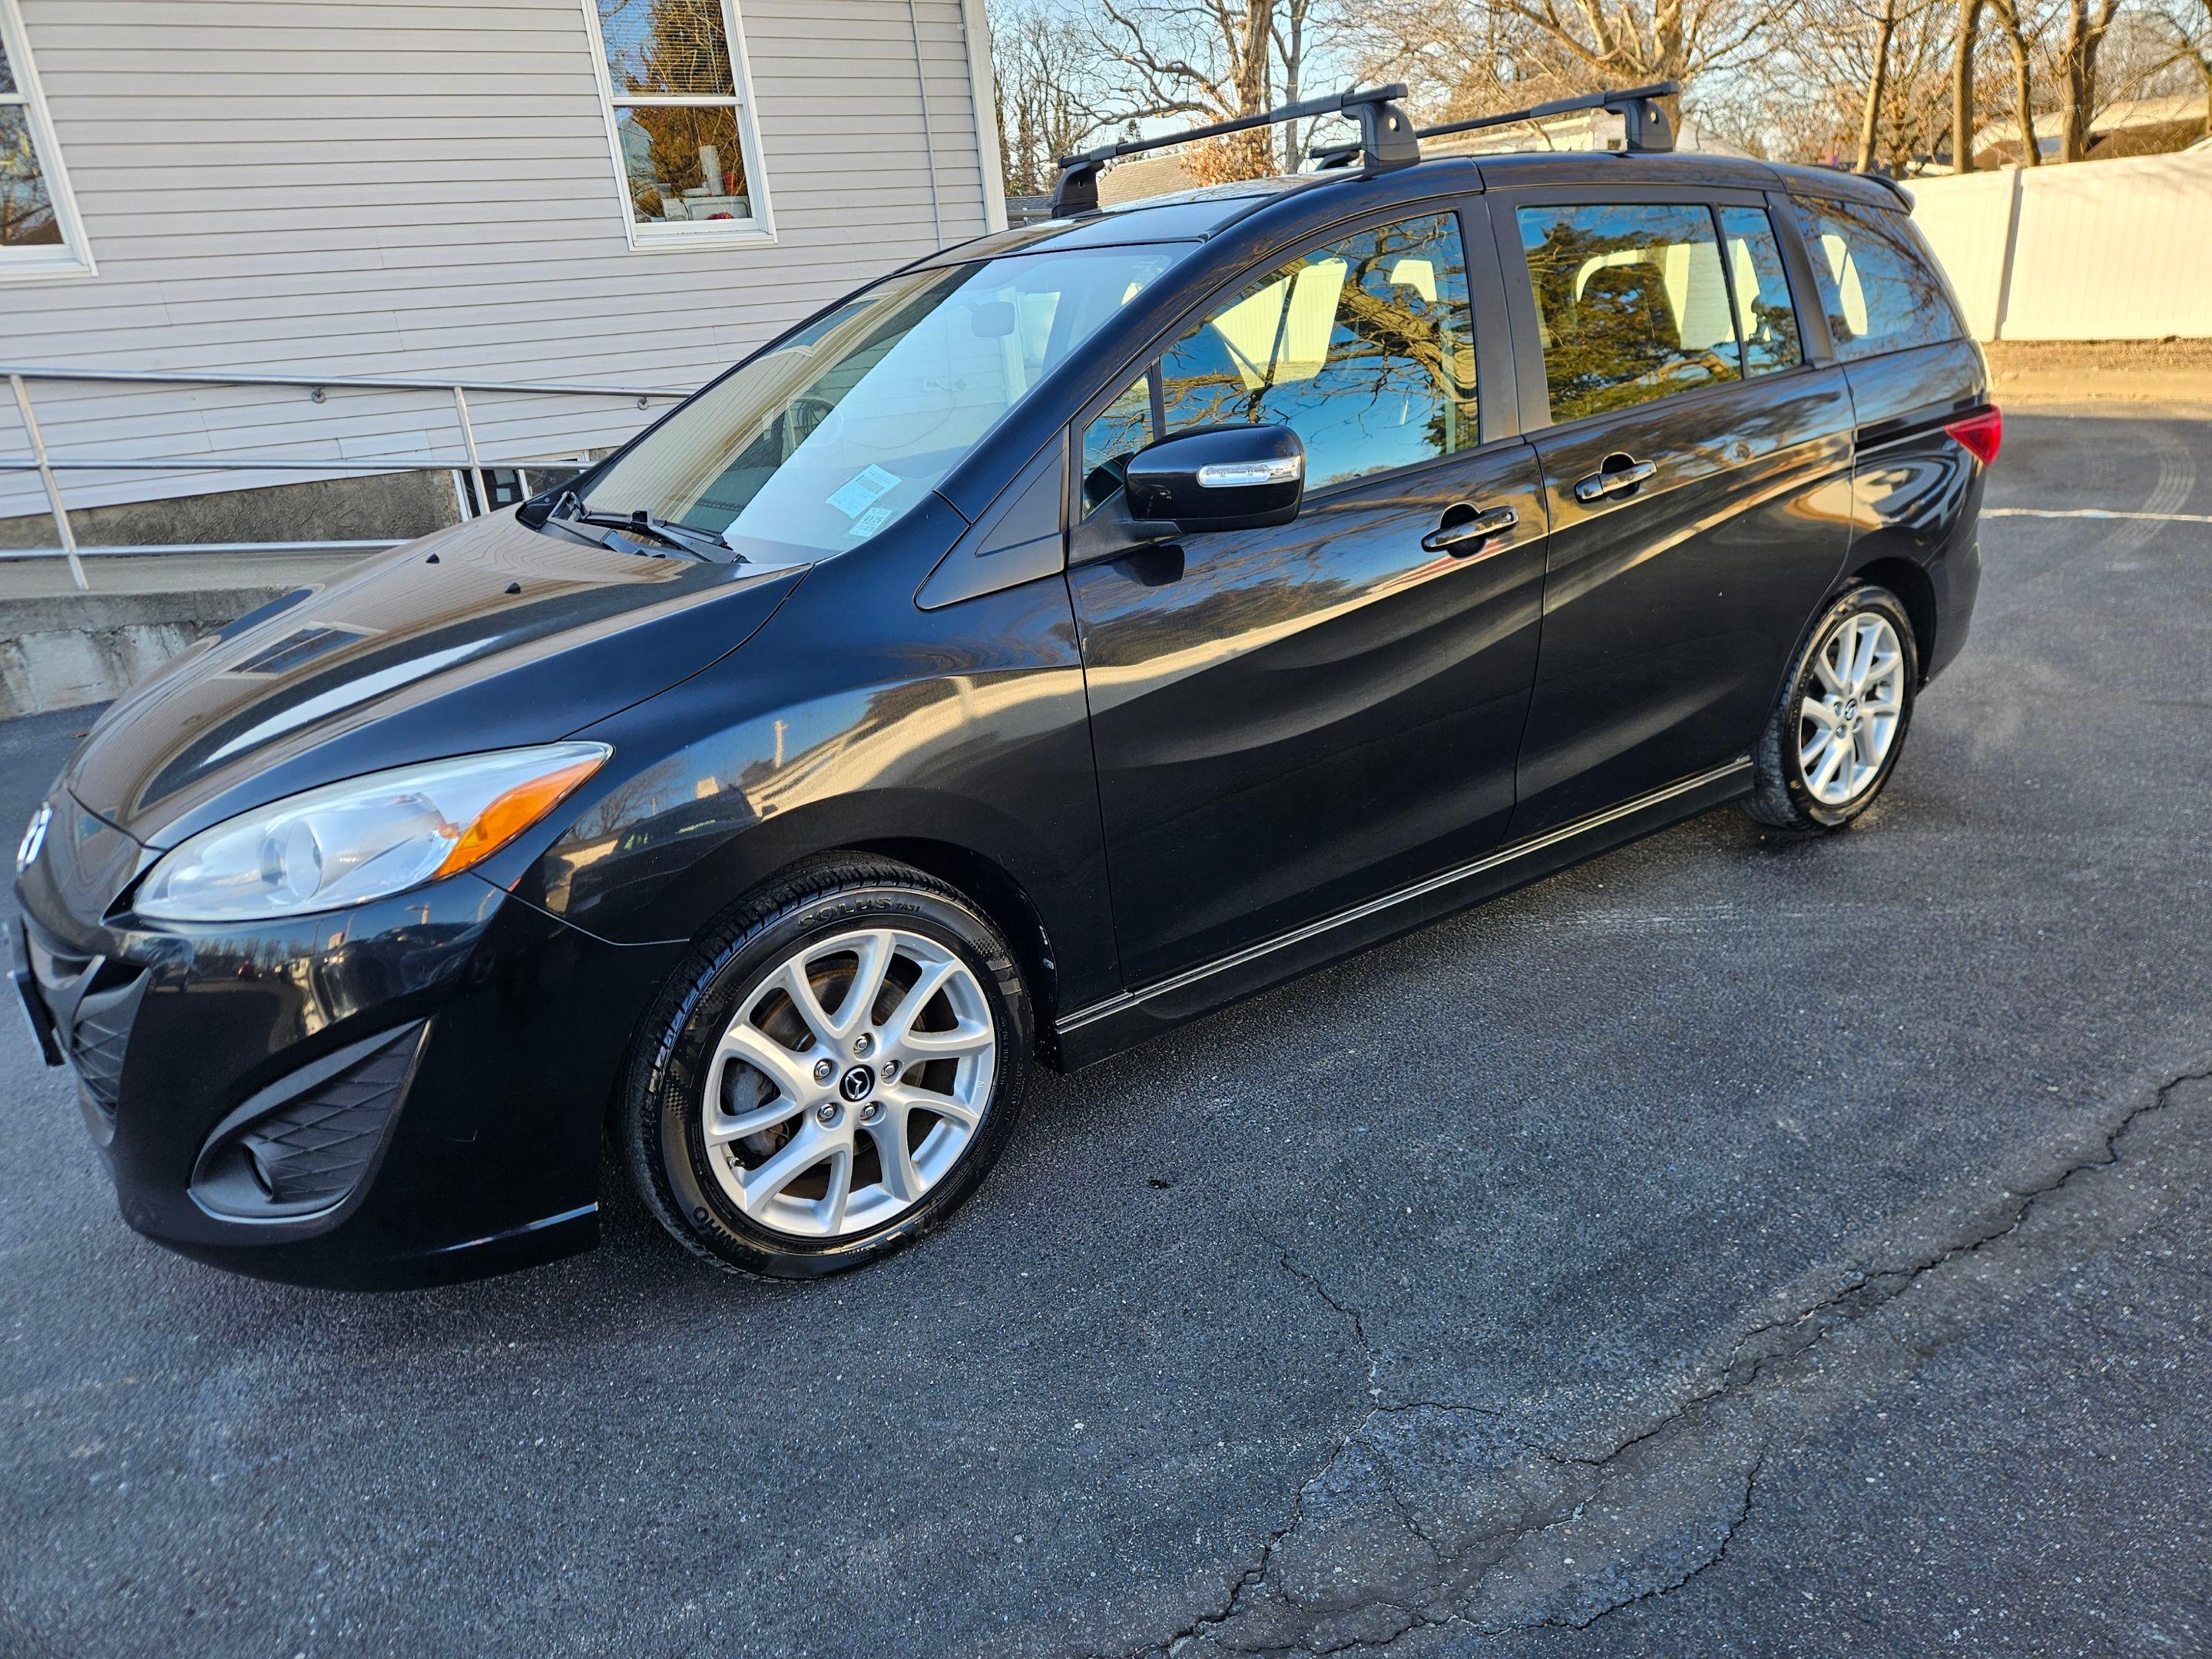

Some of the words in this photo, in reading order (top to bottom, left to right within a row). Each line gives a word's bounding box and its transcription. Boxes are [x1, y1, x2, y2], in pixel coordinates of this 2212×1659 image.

[797, 897, 892, 928] SOLUS
[895, 902, 921, 914] TA31
[693, 1206, 767, 1267] UMHO
